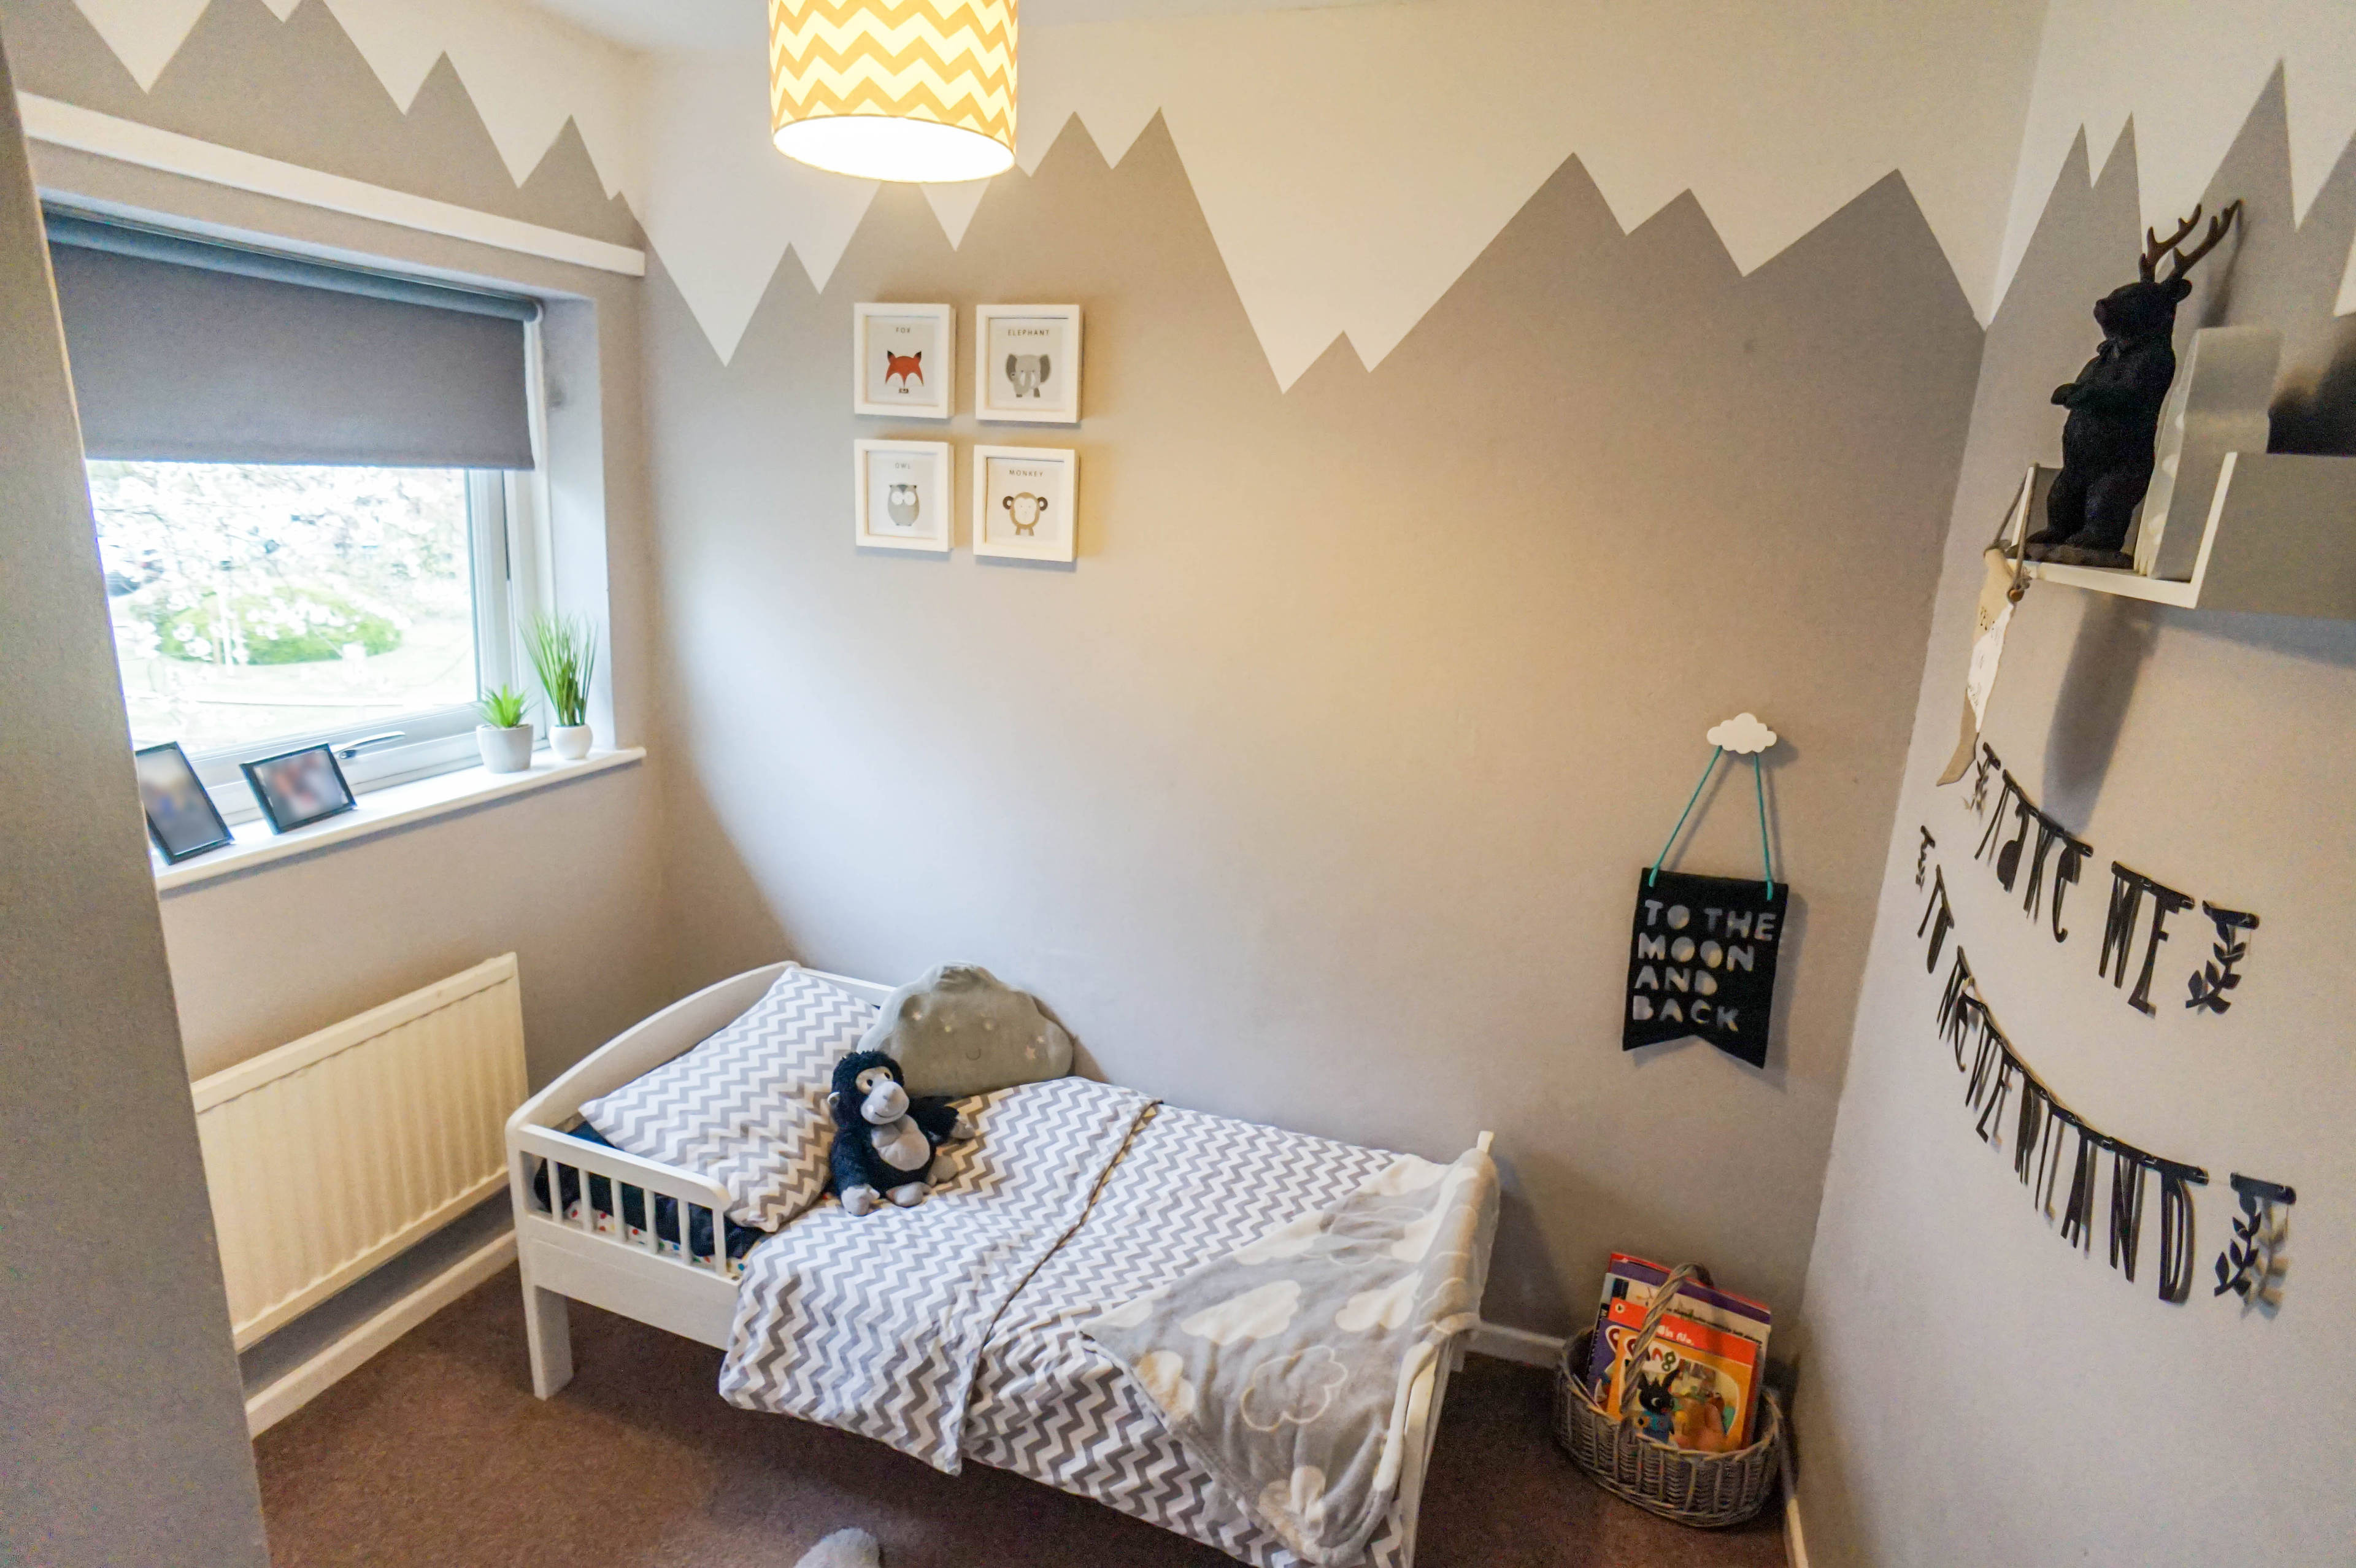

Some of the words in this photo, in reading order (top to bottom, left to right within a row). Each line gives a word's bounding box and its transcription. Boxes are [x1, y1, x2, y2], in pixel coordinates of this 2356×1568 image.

[1644, 899, 1690, 929] TO
[1703, 908, 1777, 942] THE
[2098, 861, 2195, 1015] ME
[1638, 932, 1755, 972] MOON
[1634, 965, 1718, 996] AND
[1632, 994, 1739, 1033] BACK
